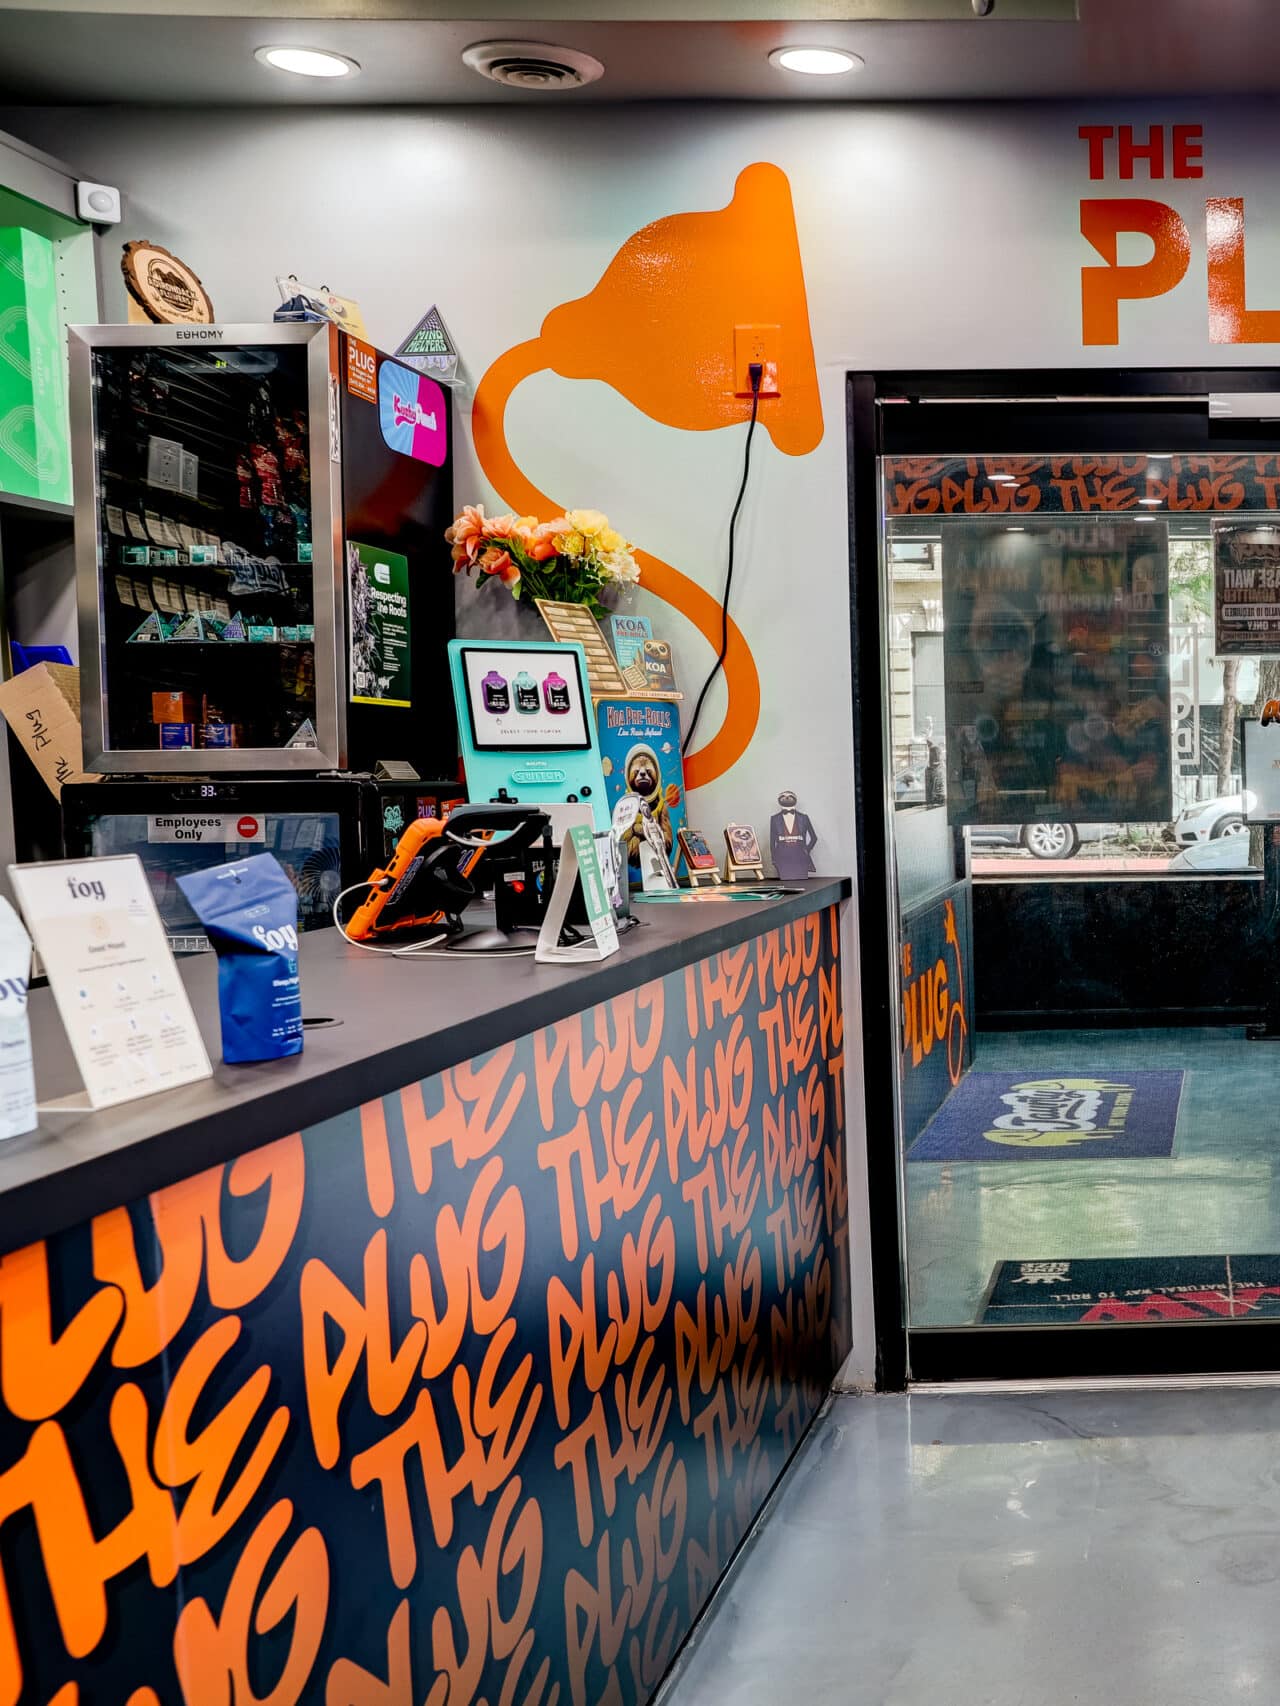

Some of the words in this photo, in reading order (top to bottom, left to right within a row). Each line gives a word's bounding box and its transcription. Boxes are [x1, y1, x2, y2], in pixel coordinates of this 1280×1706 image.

[1078, 125, 1204, 180] THE
[404, 340, 448, 353] MELTERS
[414, 330, 443, 340] MIND
[348, 346, 376, 373] PLUG
[941, 476, 1041, 513] PLUG
[1050, 475, 1140, 512] THE
[1146, 474, 1245, 511] PLUG
[370, 587, 407, 608] Respecting
[377, 603, 389, 615] the
[388, 604, 407, 617] Roots
[615, 619, 646, 632] KOA
[646, 661, 667, 673] KOA
[155, 817, 222, 829] Employees
[417, 804, 437, 818] PLUG
[175, 829, 203, 841] Only
[66, 876, 107, 901] foy
[252, 923, 299, 952] foy
[758, 979, 818, 1097] THE
[663, 1014, 754, 1185] PLUG
[762, 1063, 825, 1209] PLUG
[537, 1077, 661, 1263] THE
[681, 1122, 762, 1275] THE
[766, 1162, 824, 1295] THE
[1049, 1292, 1092, 1304] ROLL
[1098, 1290, 1117, 1300] TO
[1123, 1287, 1153, 1298] WAY
[1159, 1282, 1230, 1295] NATURAL
[301, 1155, 527, 1470] PLUG
[546, 1193, 676, 1431] PLUG
[674, 1229, 762, 1427] PLUG
[694, 1333, 770, 1501] THE
[350, 1317, 543, 1590] THE
[554, 1335, 672, 1548] THE
[564, 1441, 688, 1706] PLUG
